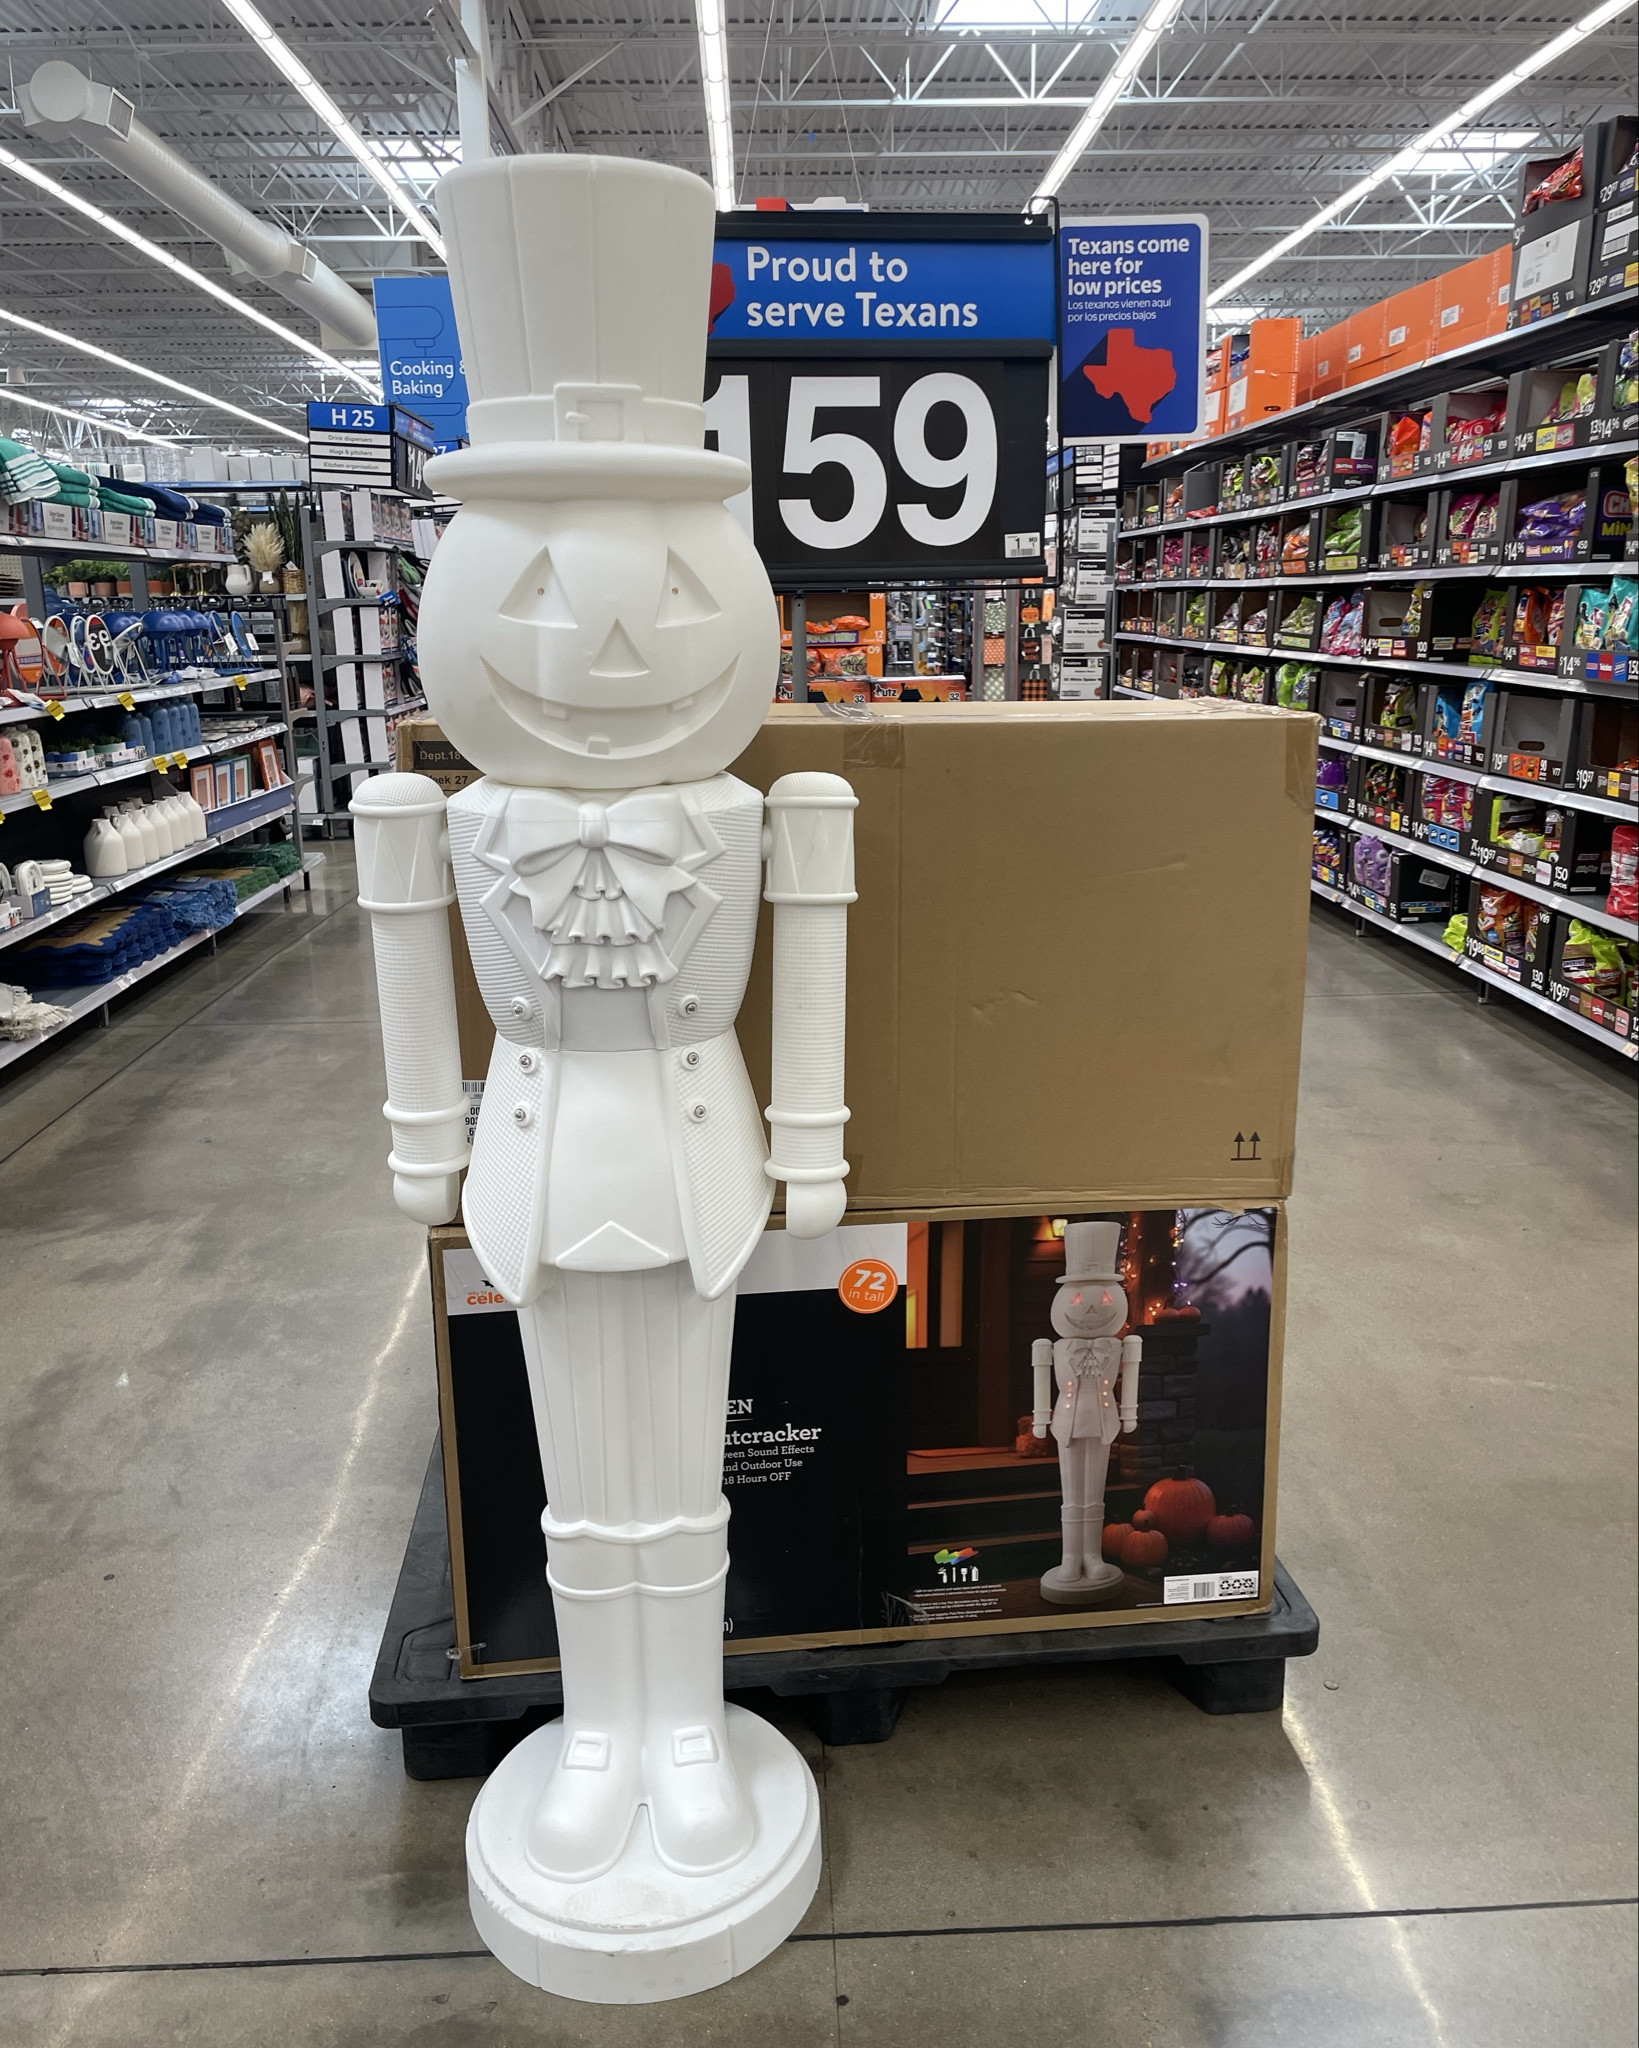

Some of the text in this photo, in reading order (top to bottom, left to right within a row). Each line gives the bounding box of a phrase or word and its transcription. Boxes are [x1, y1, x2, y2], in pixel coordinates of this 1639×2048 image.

[1068, 238, 1190, 255] Texans come
[747, 246, 908, 282] Proud to
[1068, 257, 1143, 275] here for
[1068, 277, 1162, 298] low prices
[747, 292, 978, 327] serve Texans
[1068, 298, 1172, 310] Los texanos vienen aquí
[1068, 310, 1157, 323] por los precios bajos
[390, 361, 453, 379] Cooking
[392, 380, 443, 398] Baking
[331, 408, 375, 427] H 25
[875, 630, 884, 639] 12
[1416, 641, 1428, 653] 100
[1560, 656, 1581, 676] $1496
[854, 695, 864, 703] 32
[455, 775, 468, 784] 27
[1576, 768, 1595, 790] $1997
[1554, 867, 1568, 881] 150
[1532, 969, 1543, 984] 130
[1550, 980, 1570, 1002] $1997
[854, 1269, 887, 1291] 72
[848, 1289, 885, 1303] in tall
[747, 1446, 779, 1457] Sound
[781, 1444, 815, 1455] Effects
[740, 1459, 782, 1471] Outdoor
[784, 1458, 803, 1468] Use
[737, 1475, 767, 1484] Hours
[769, 1471, 791, 1481] OFF
